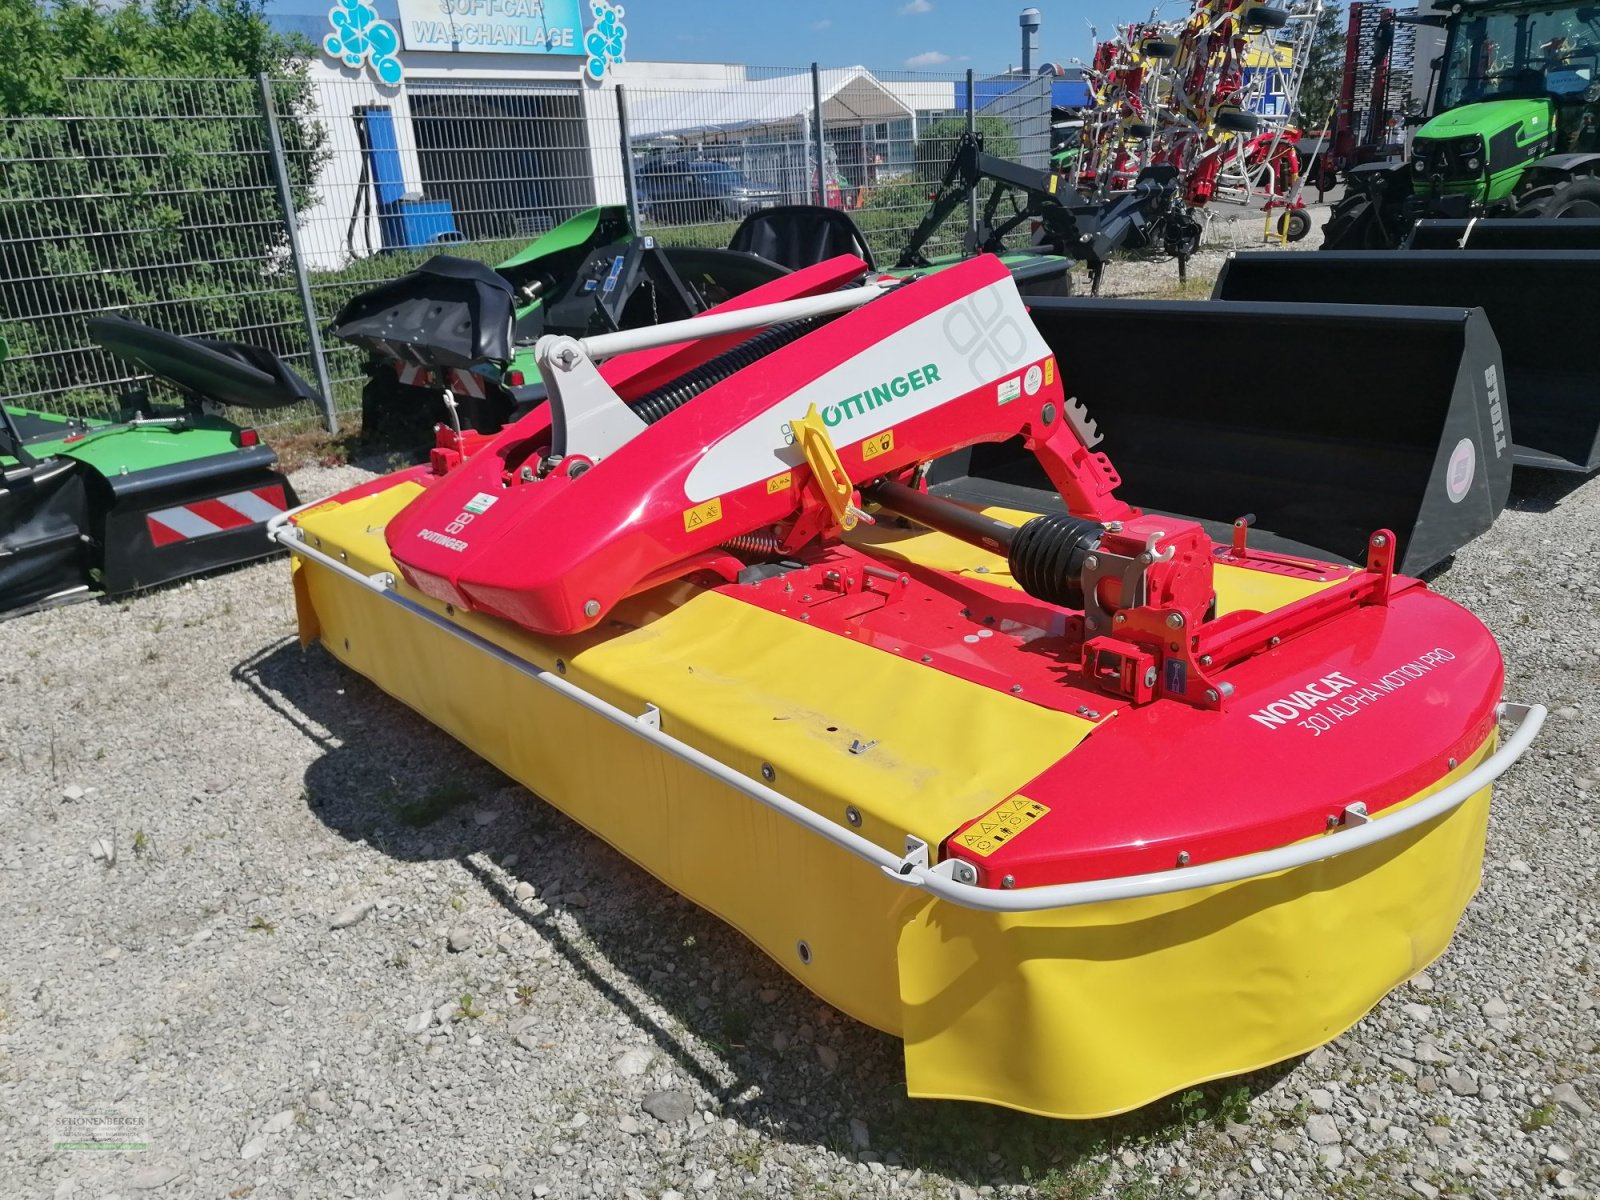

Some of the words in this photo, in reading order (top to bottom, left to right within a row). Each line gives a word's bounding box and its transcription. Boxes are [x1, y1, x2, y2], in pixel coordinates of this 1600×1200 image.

[412, 21, 574, 47] WASCHANLAGE
[439, 0, 545, 18] SOFT-CAR
[822, 363, 942, 427] ÖTTINGER
[1485, 364, 1506, 459] STOLL
[1249, 671, 1358, 729] NOVACAT
[1297, 712, 1337, 737] 301
[1326, 687, 1385, 721] ALPHA
[1370, 660, 1432, 693] MOTION
[1419, 647, 1456, 668] PRO
